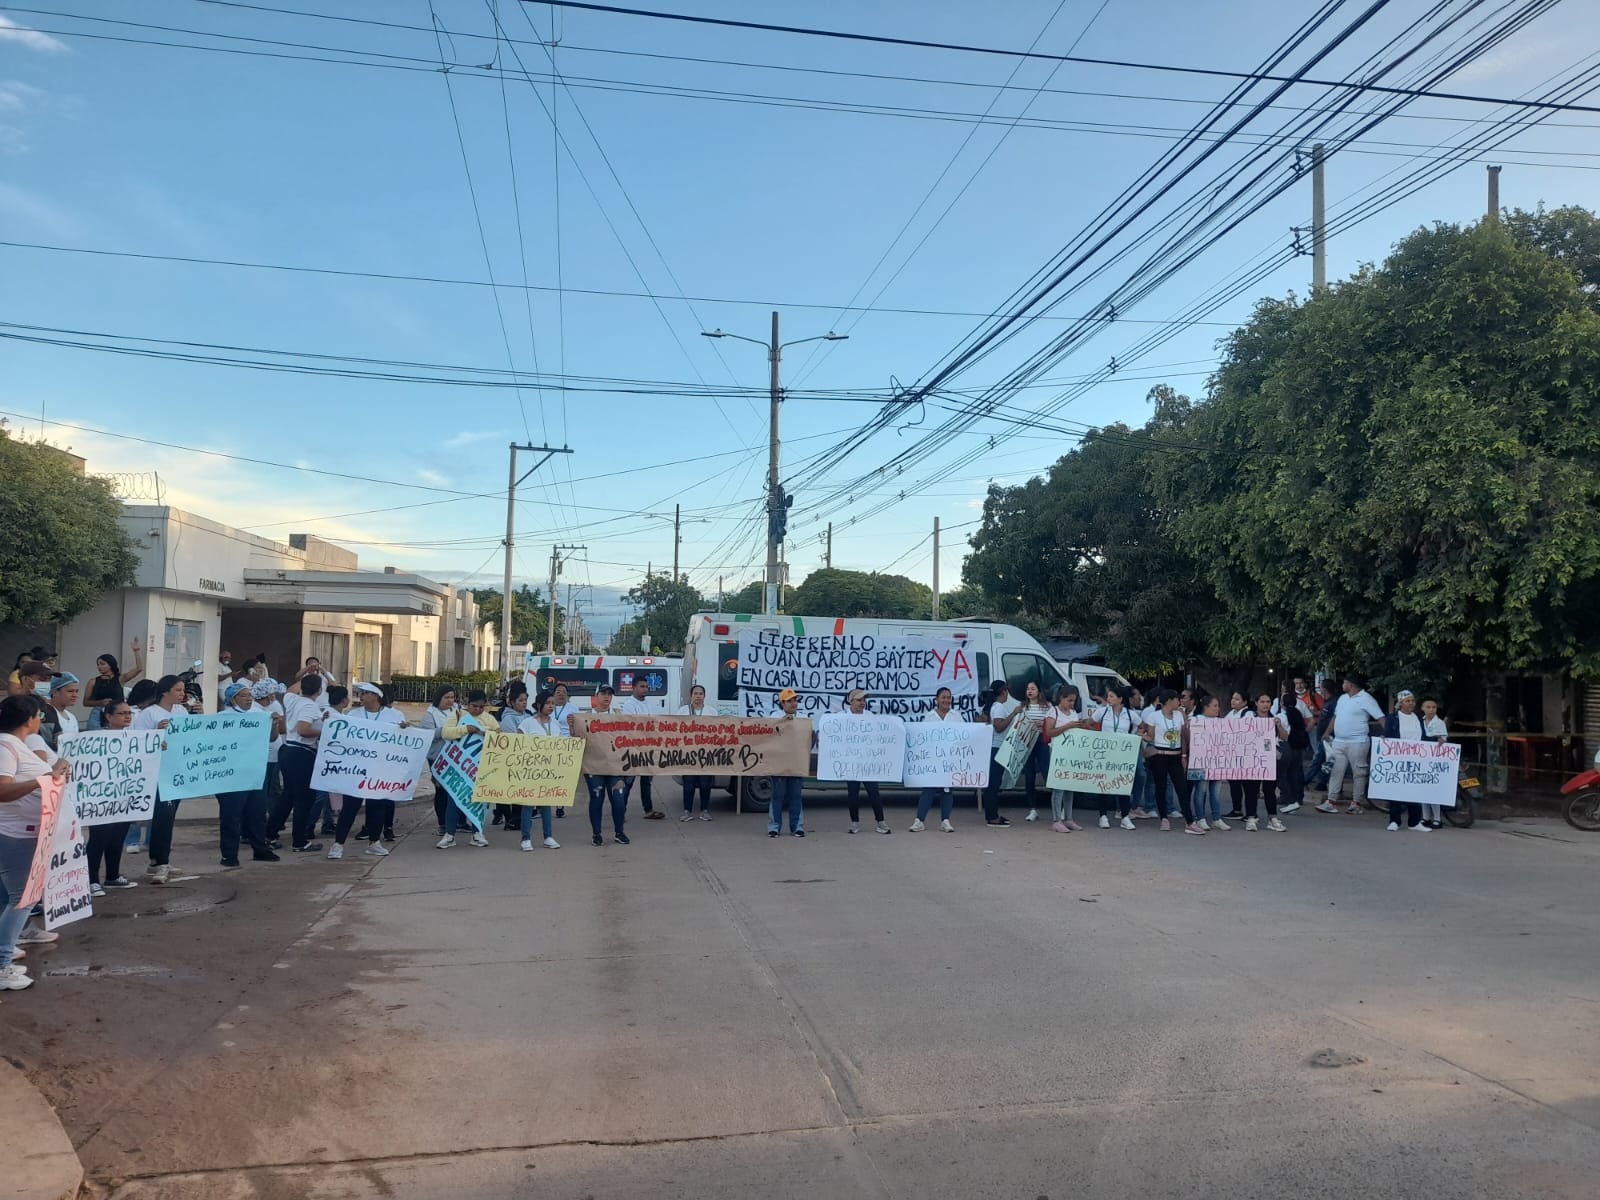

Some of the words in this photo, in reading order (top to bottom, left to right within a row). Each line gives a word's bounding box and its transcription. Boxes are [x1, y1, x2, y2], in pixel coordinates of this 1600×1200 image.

[200, 578, 226, 592] FARMACIA
[748, 646, 801, 666] JUAN
[806, 650, 871, 669] CARLOS
[740, 666, 763, 685] EN
[765, 669, 799, 689] CASA
[802, 673, 821, 689] LO
[824, 674, 921, 692] ESPERAMOS
[745, 692, 764, 709] LA
[880, 699, 909, 715] NOS
[206, 720, 218, 730] NO
[329, 718, 424, 750] PREVISALUD
[1061, 732, 1075, 748] YA
[1193, 732, 1206, 747] ES
[129, 735, 140, 754] A
[145, 733, 162, 756] LA
[487, 735, 510, 750] NO
[513, 739, 529, 752] AL
[935, 745, 946, 758] LA
[1243, 744, 1258, 757] ES
[324, 740, 379, 760] SOMOS
[385, 752, 410, 764] UNA
[486, 752, 499, 765] TE
[557, 754, 575, 767] TUS
[107, 757, 143, 778] PARA
[621, 749, 655, 772] JUAN
[658, 750, 698, 769] CARLOS
[1055, 758, 1068, 768] NO
[1193, 755, 1246, 769] MOMENTO
[1253, 755, 1268, 769] DE
[173, 774, 185, 787] ES
[951, 771, 988, 787] SALUD
[1055, 769, 1071, 781] QUE
[476, 784, 504, 799] JUAN
[506, 786, 535, 799] CARLOS
[50, 850, 67, 870] AL
